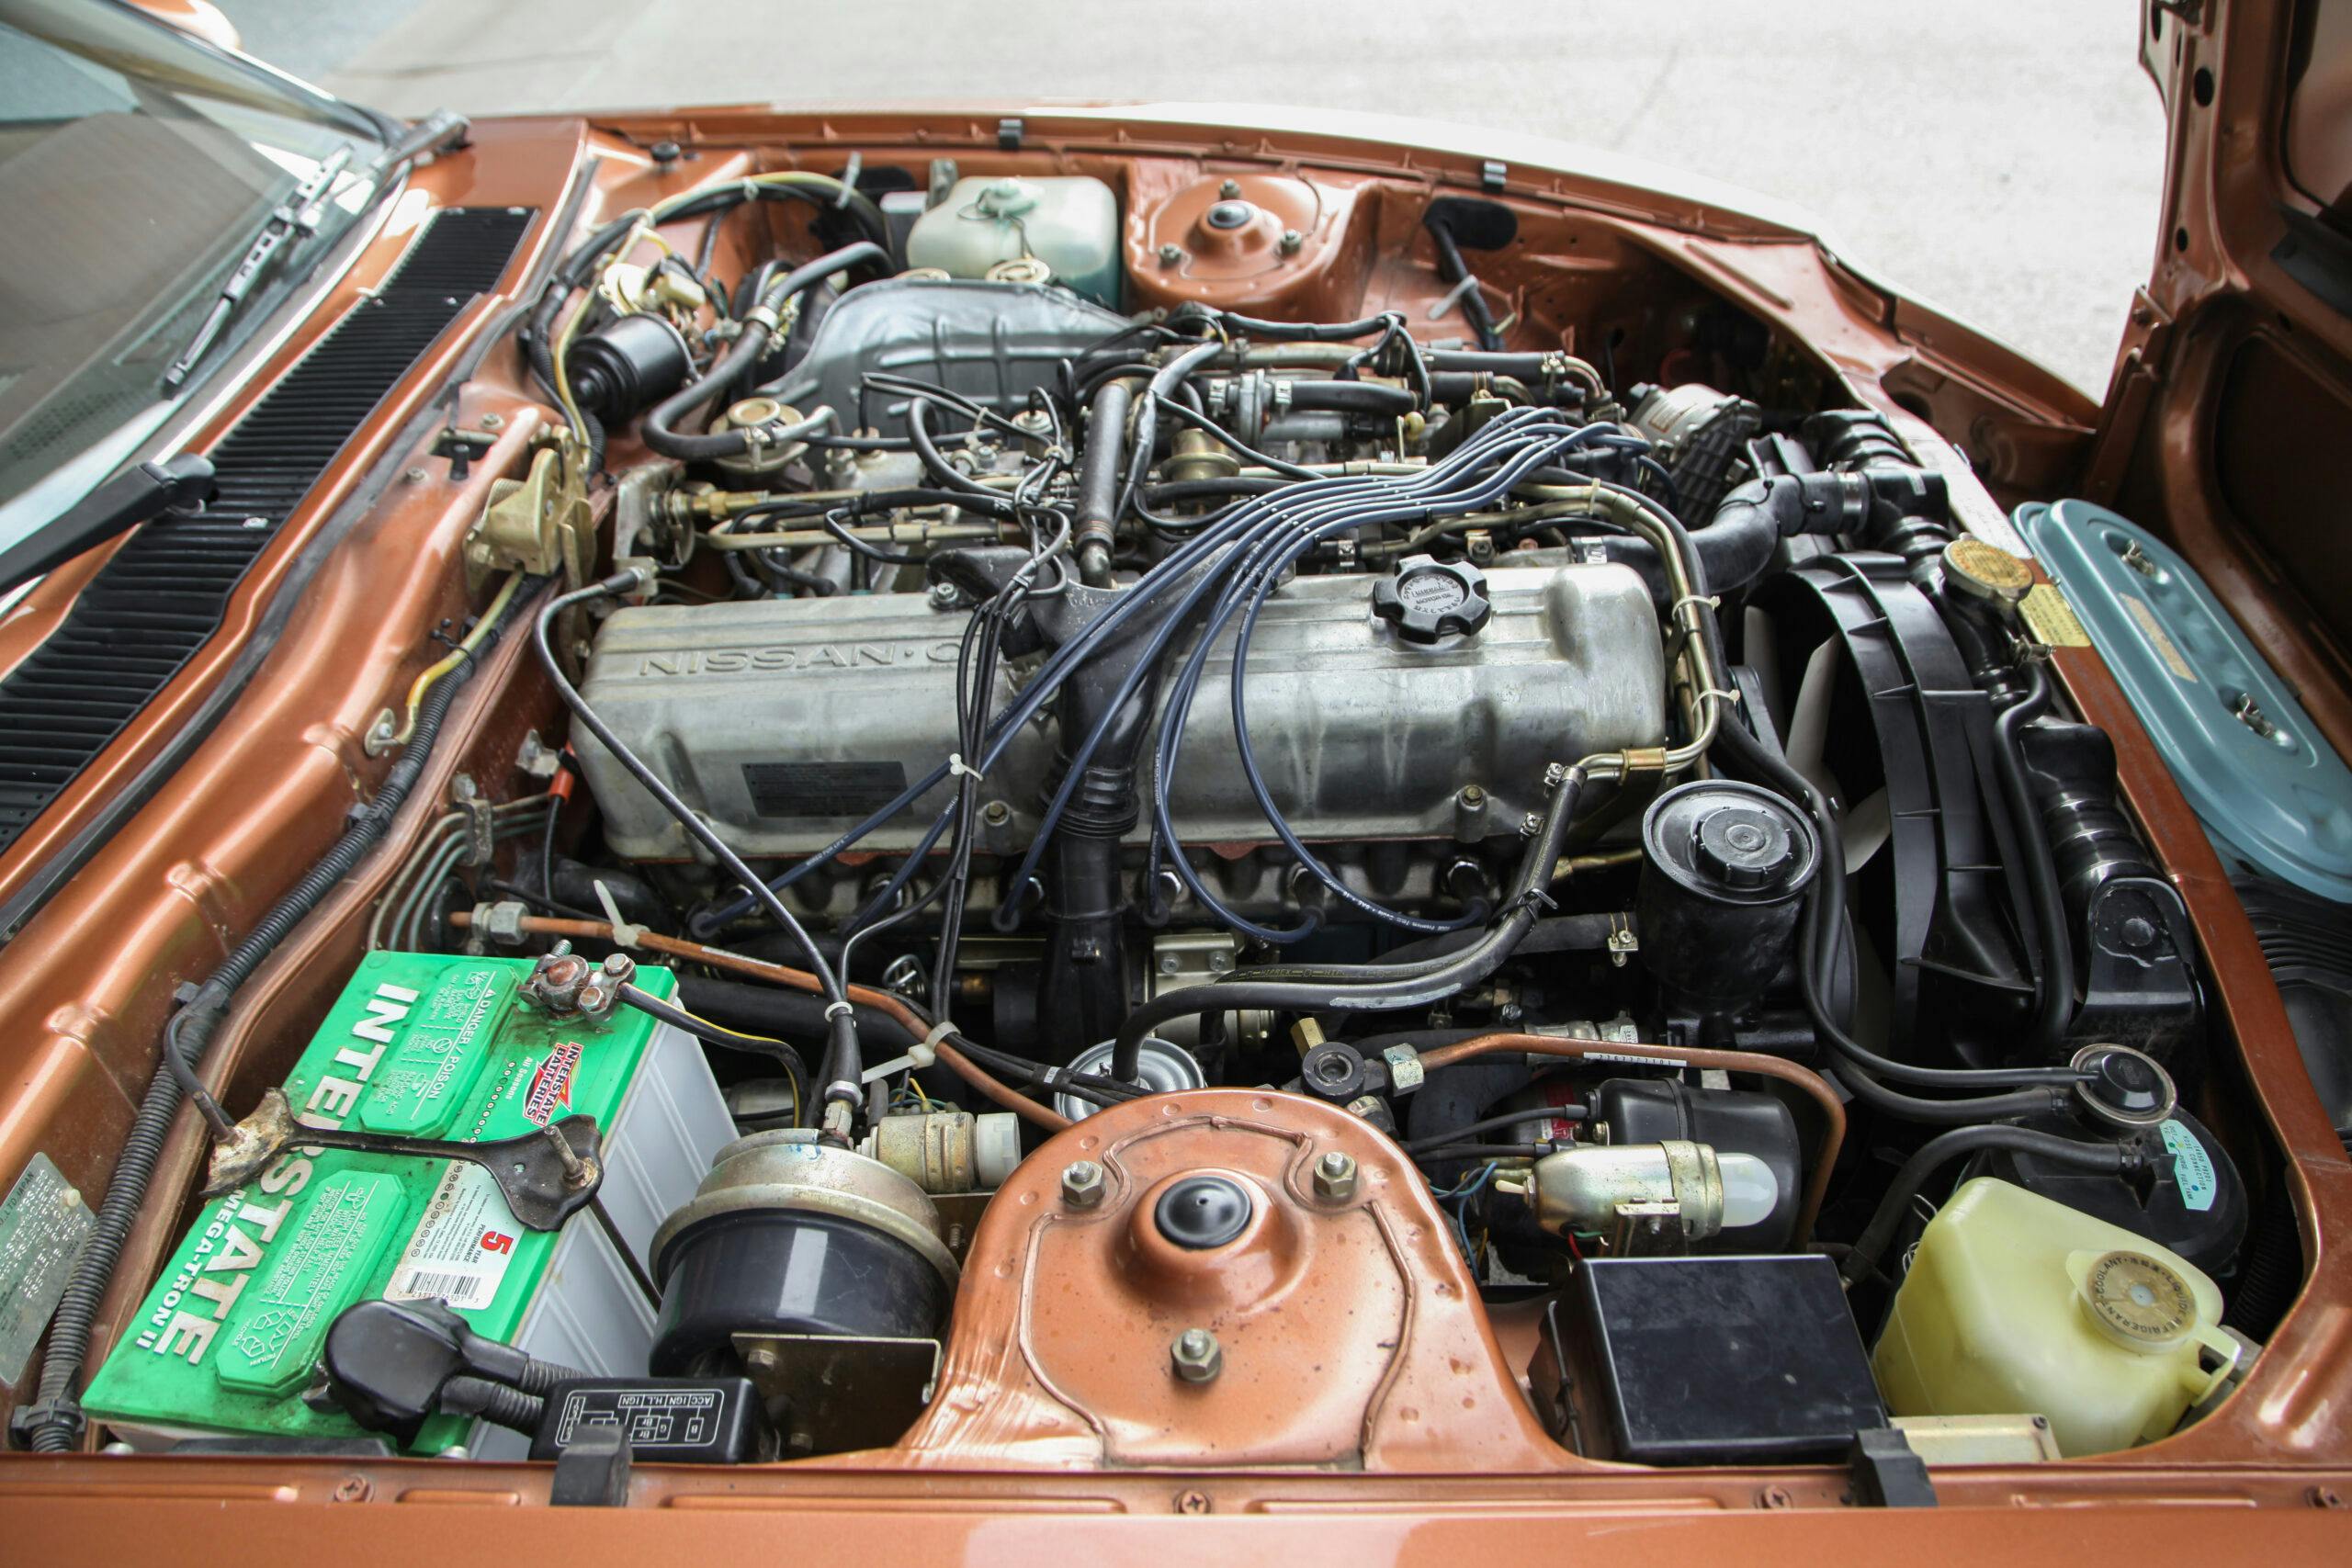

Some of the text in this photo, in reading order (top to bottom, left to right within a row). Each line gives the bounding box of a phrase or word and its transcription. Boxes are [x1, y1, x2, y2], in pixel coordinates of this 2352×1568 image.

[639, 642, 896, 676] NISSAN
[458, 999, 492, 1044] DANGER
[426, 1055, 459, 1099] POISON
[508, 1056, 534, 1100] All Seasons
[524, 1047, 566, 1116] BATTERIES
[534, 1044, 582, 1123] INTERSTATE
[2189, 1153, 2207, 1190] CONNECTION
[148, 1188, 246, 1328] MEGA-TRON
[461, 1224, 486, 1262] PERFORMANCE
[469, 1249, 482, 1263] YEAR
[475, 1230, 516, 1255] 5
[2095, 1257, 2124, 1294] COOLANT
[622, 1396, 640, 1406] IGN
[669, 1396, 688, 1406] IGN
[690, 1395, 712, 1405] ACC
[659, 1424, 668, 1434] G
[690, 1425, 698, 1435] B
